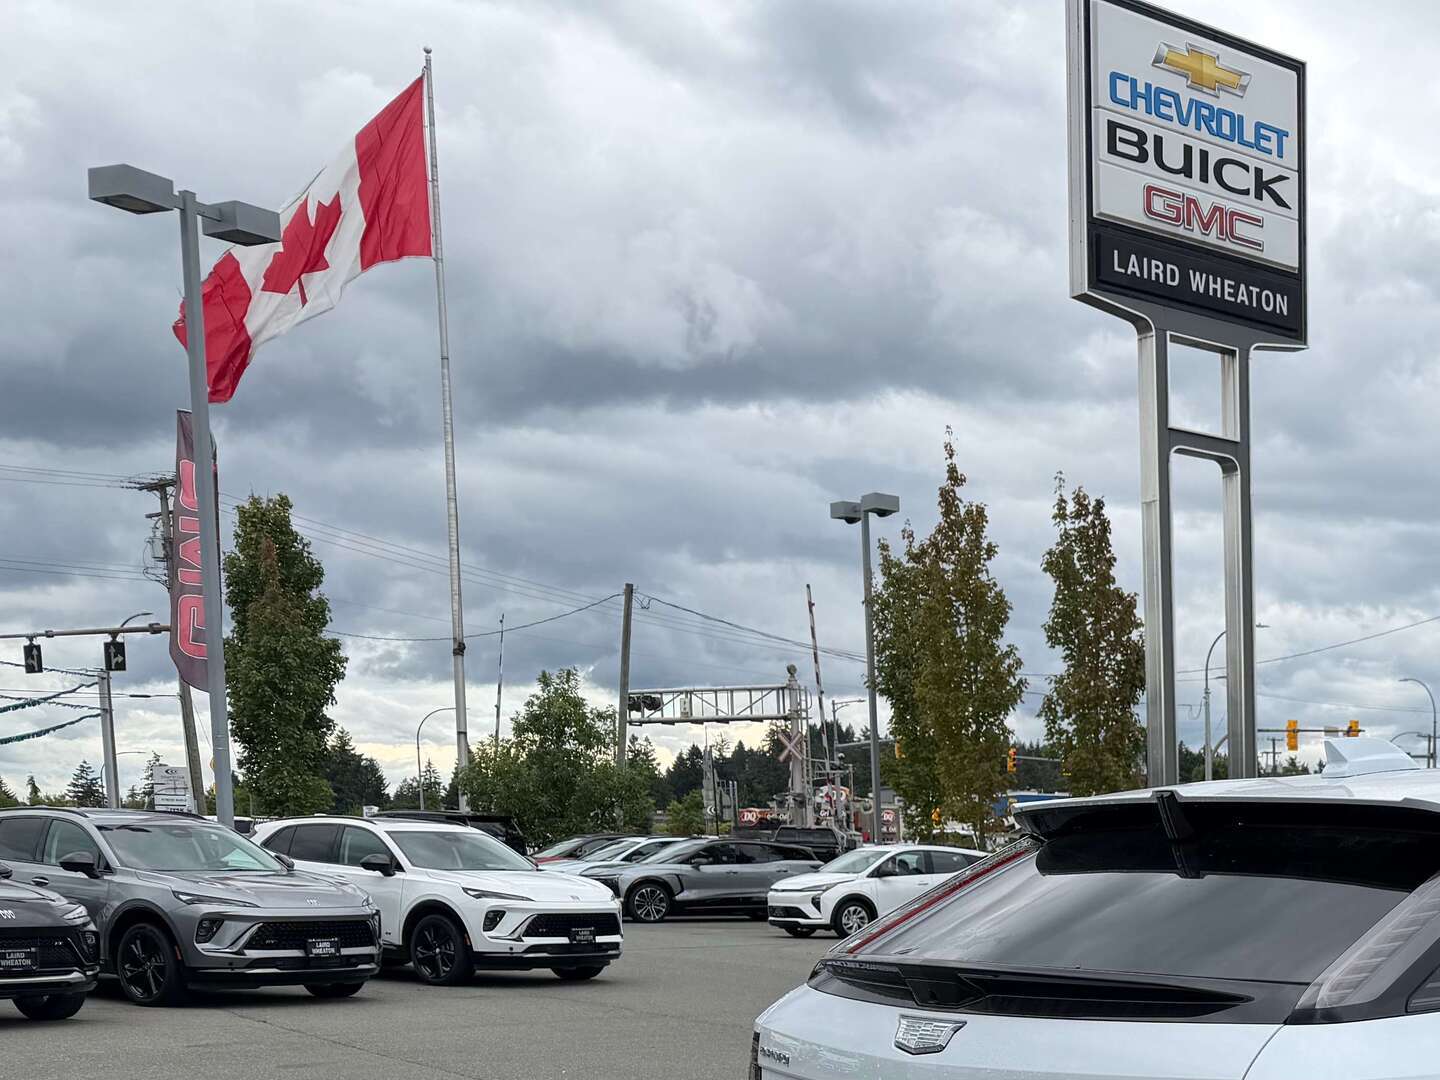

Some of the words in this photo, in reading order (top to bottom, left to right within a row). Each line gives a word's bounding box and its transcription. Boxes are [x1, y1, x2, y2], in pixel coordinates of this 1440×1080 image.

[1109, 70, 1289, 160] CHEVROLET
[1107, 119, 1292, 210] BUICK
[1143, 183, 1264, 250] GMC
[1113, 250, 1180, 286] LAIRD
[1189, 268, 1288, 316] WHEATON
[742, 811, 757, 822] DQ
